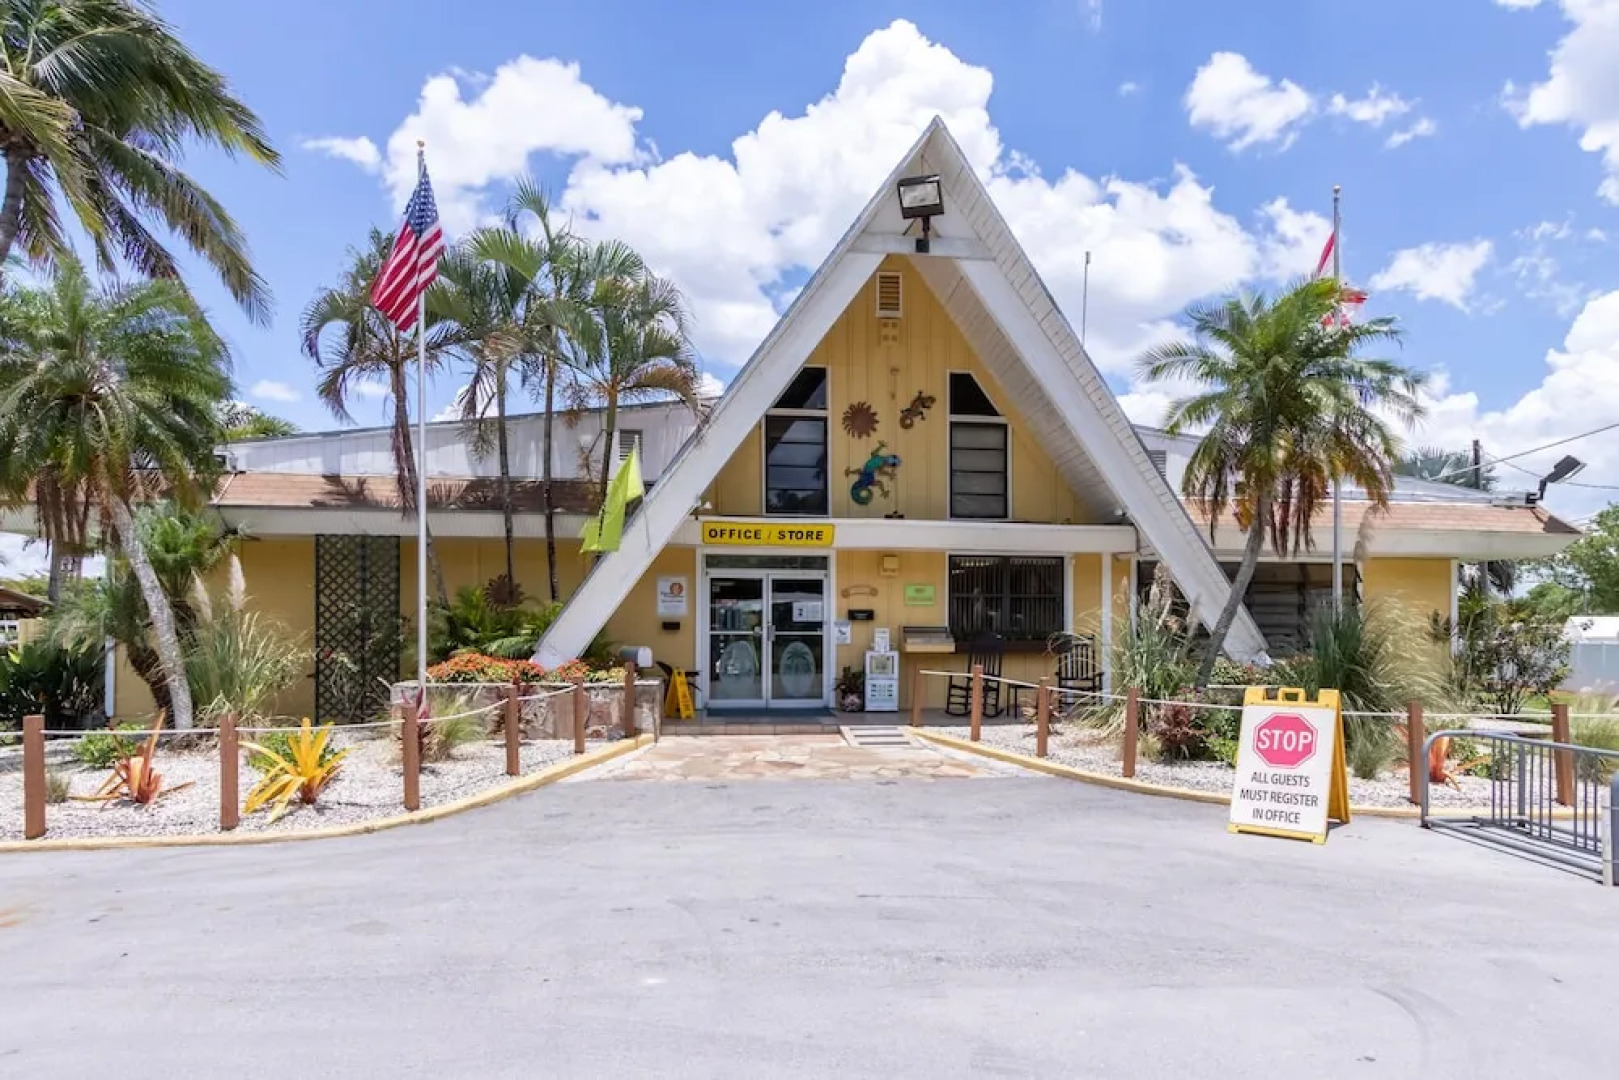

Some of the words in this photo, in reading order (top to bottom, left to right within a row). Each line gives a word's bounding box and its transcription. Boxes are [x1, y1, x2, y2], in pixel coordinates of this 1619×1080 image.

[708, 528, 762, 540] OFFICE
[778, 530, 824, 540] STORE
[1257, 728, 1313, 752] STOP
[1251, 772, 1269, 785] ALL
[1270, 773, 1310, 788] GUESTS
[1240, 789, 1269, 801] MUST
[1270, 791, 1319, 807] REGISTER
[1252, 808, 1264, 820] IN
[1265, 809, 1301, 824] OFFICE
